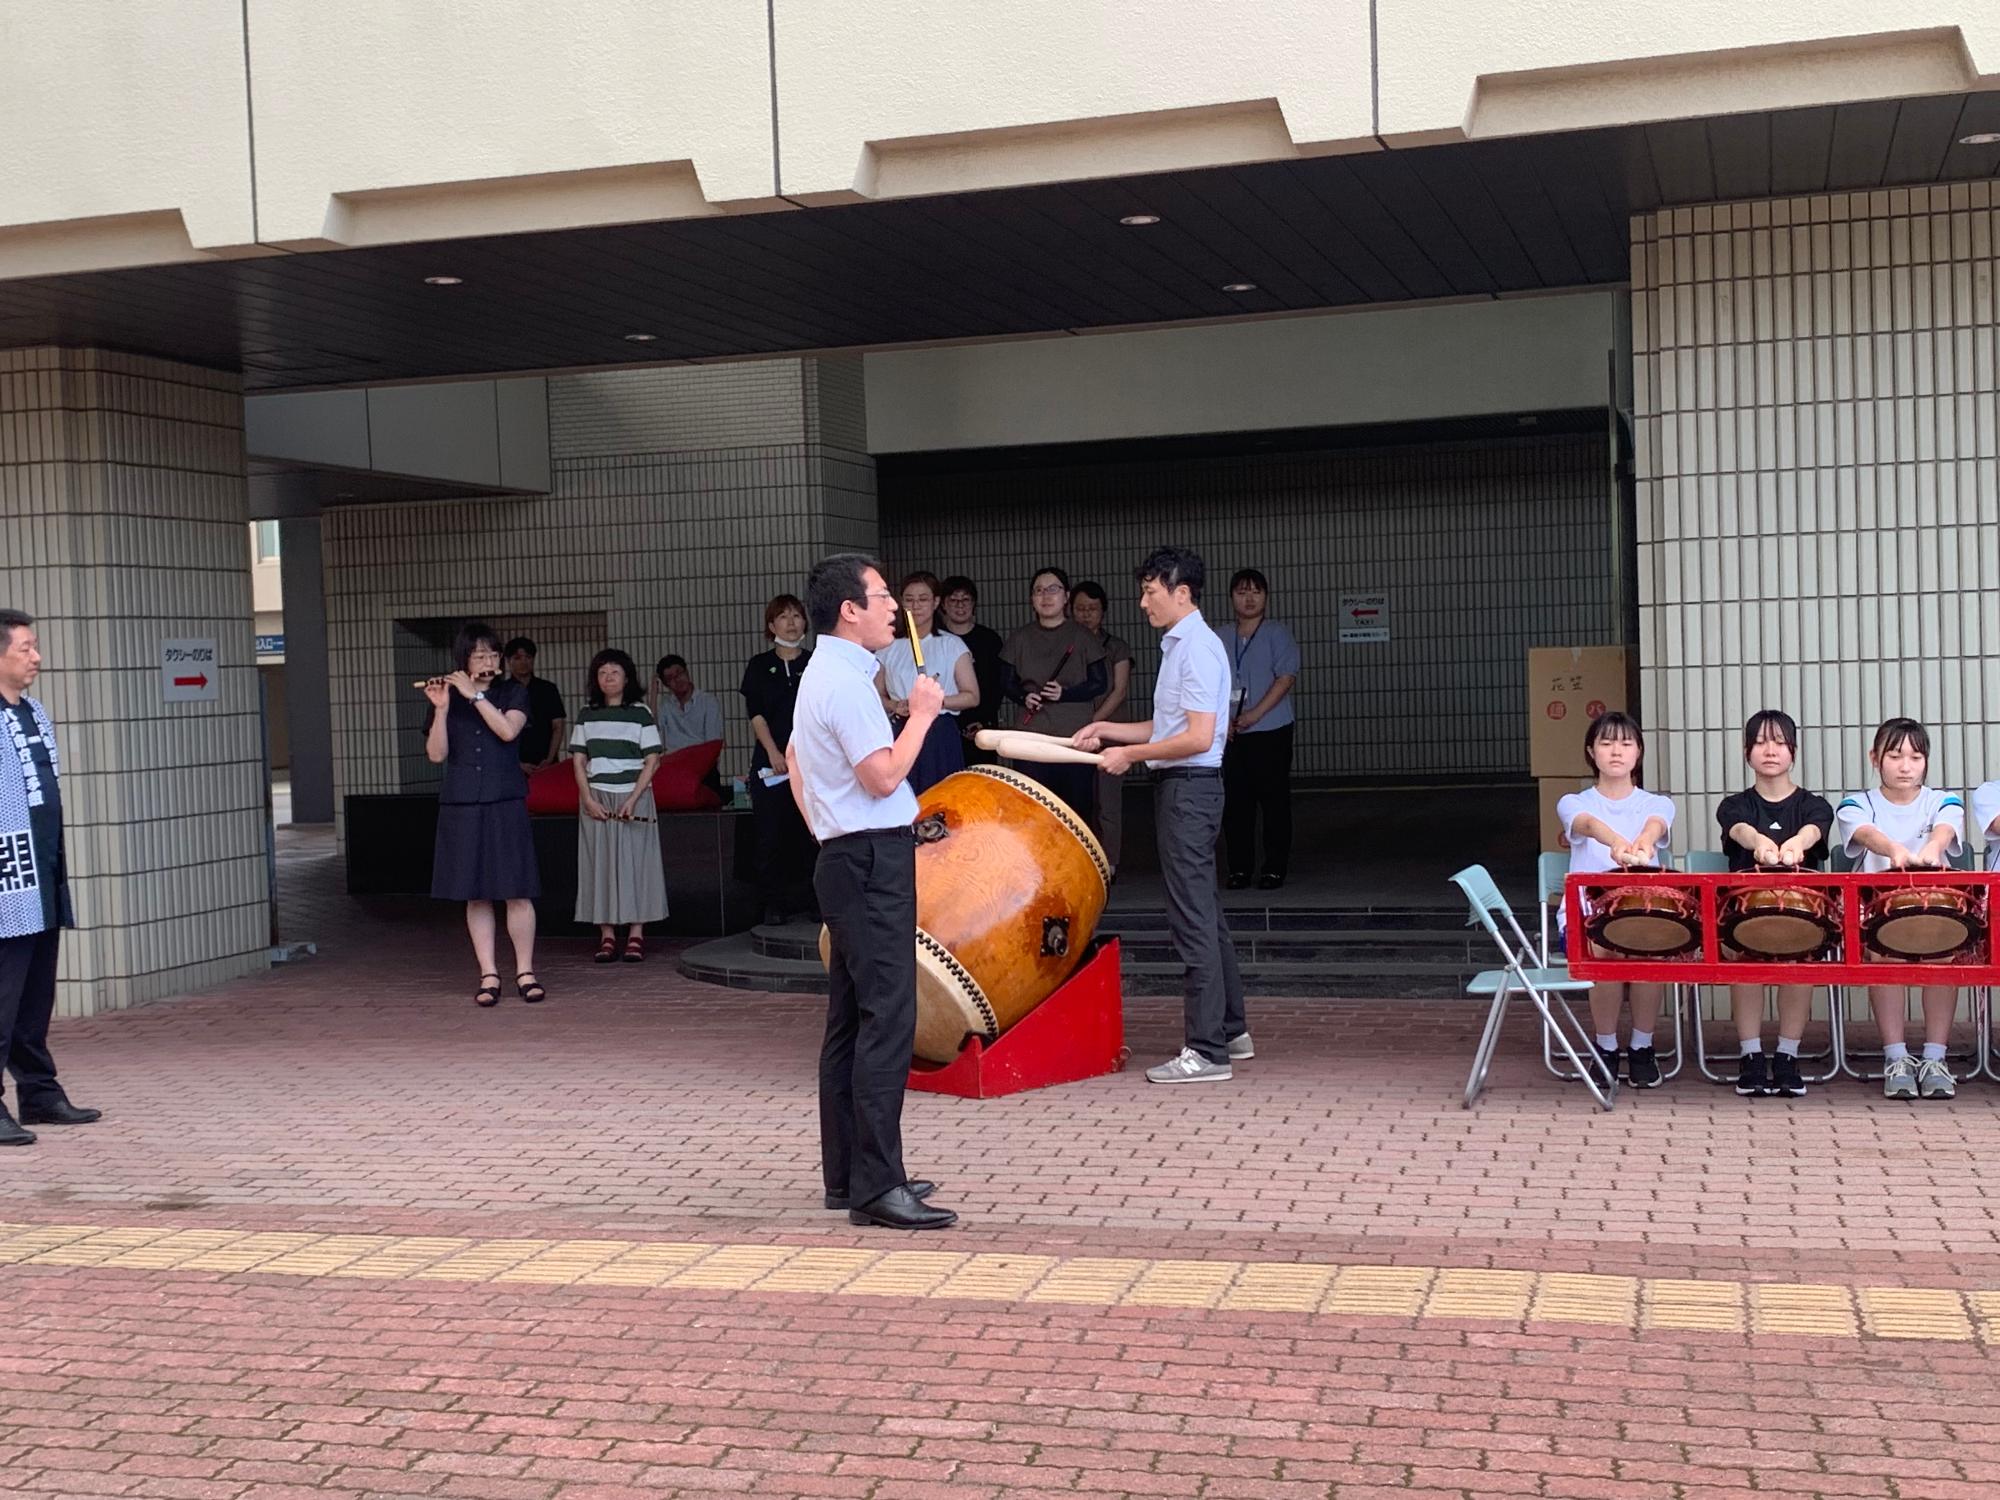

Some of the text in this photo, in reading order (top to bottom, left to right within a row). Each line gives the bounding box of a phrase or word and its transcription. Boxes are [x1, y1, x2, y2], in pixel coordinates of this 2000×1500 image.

[165, 647, 213, 662] タクシーのりば
